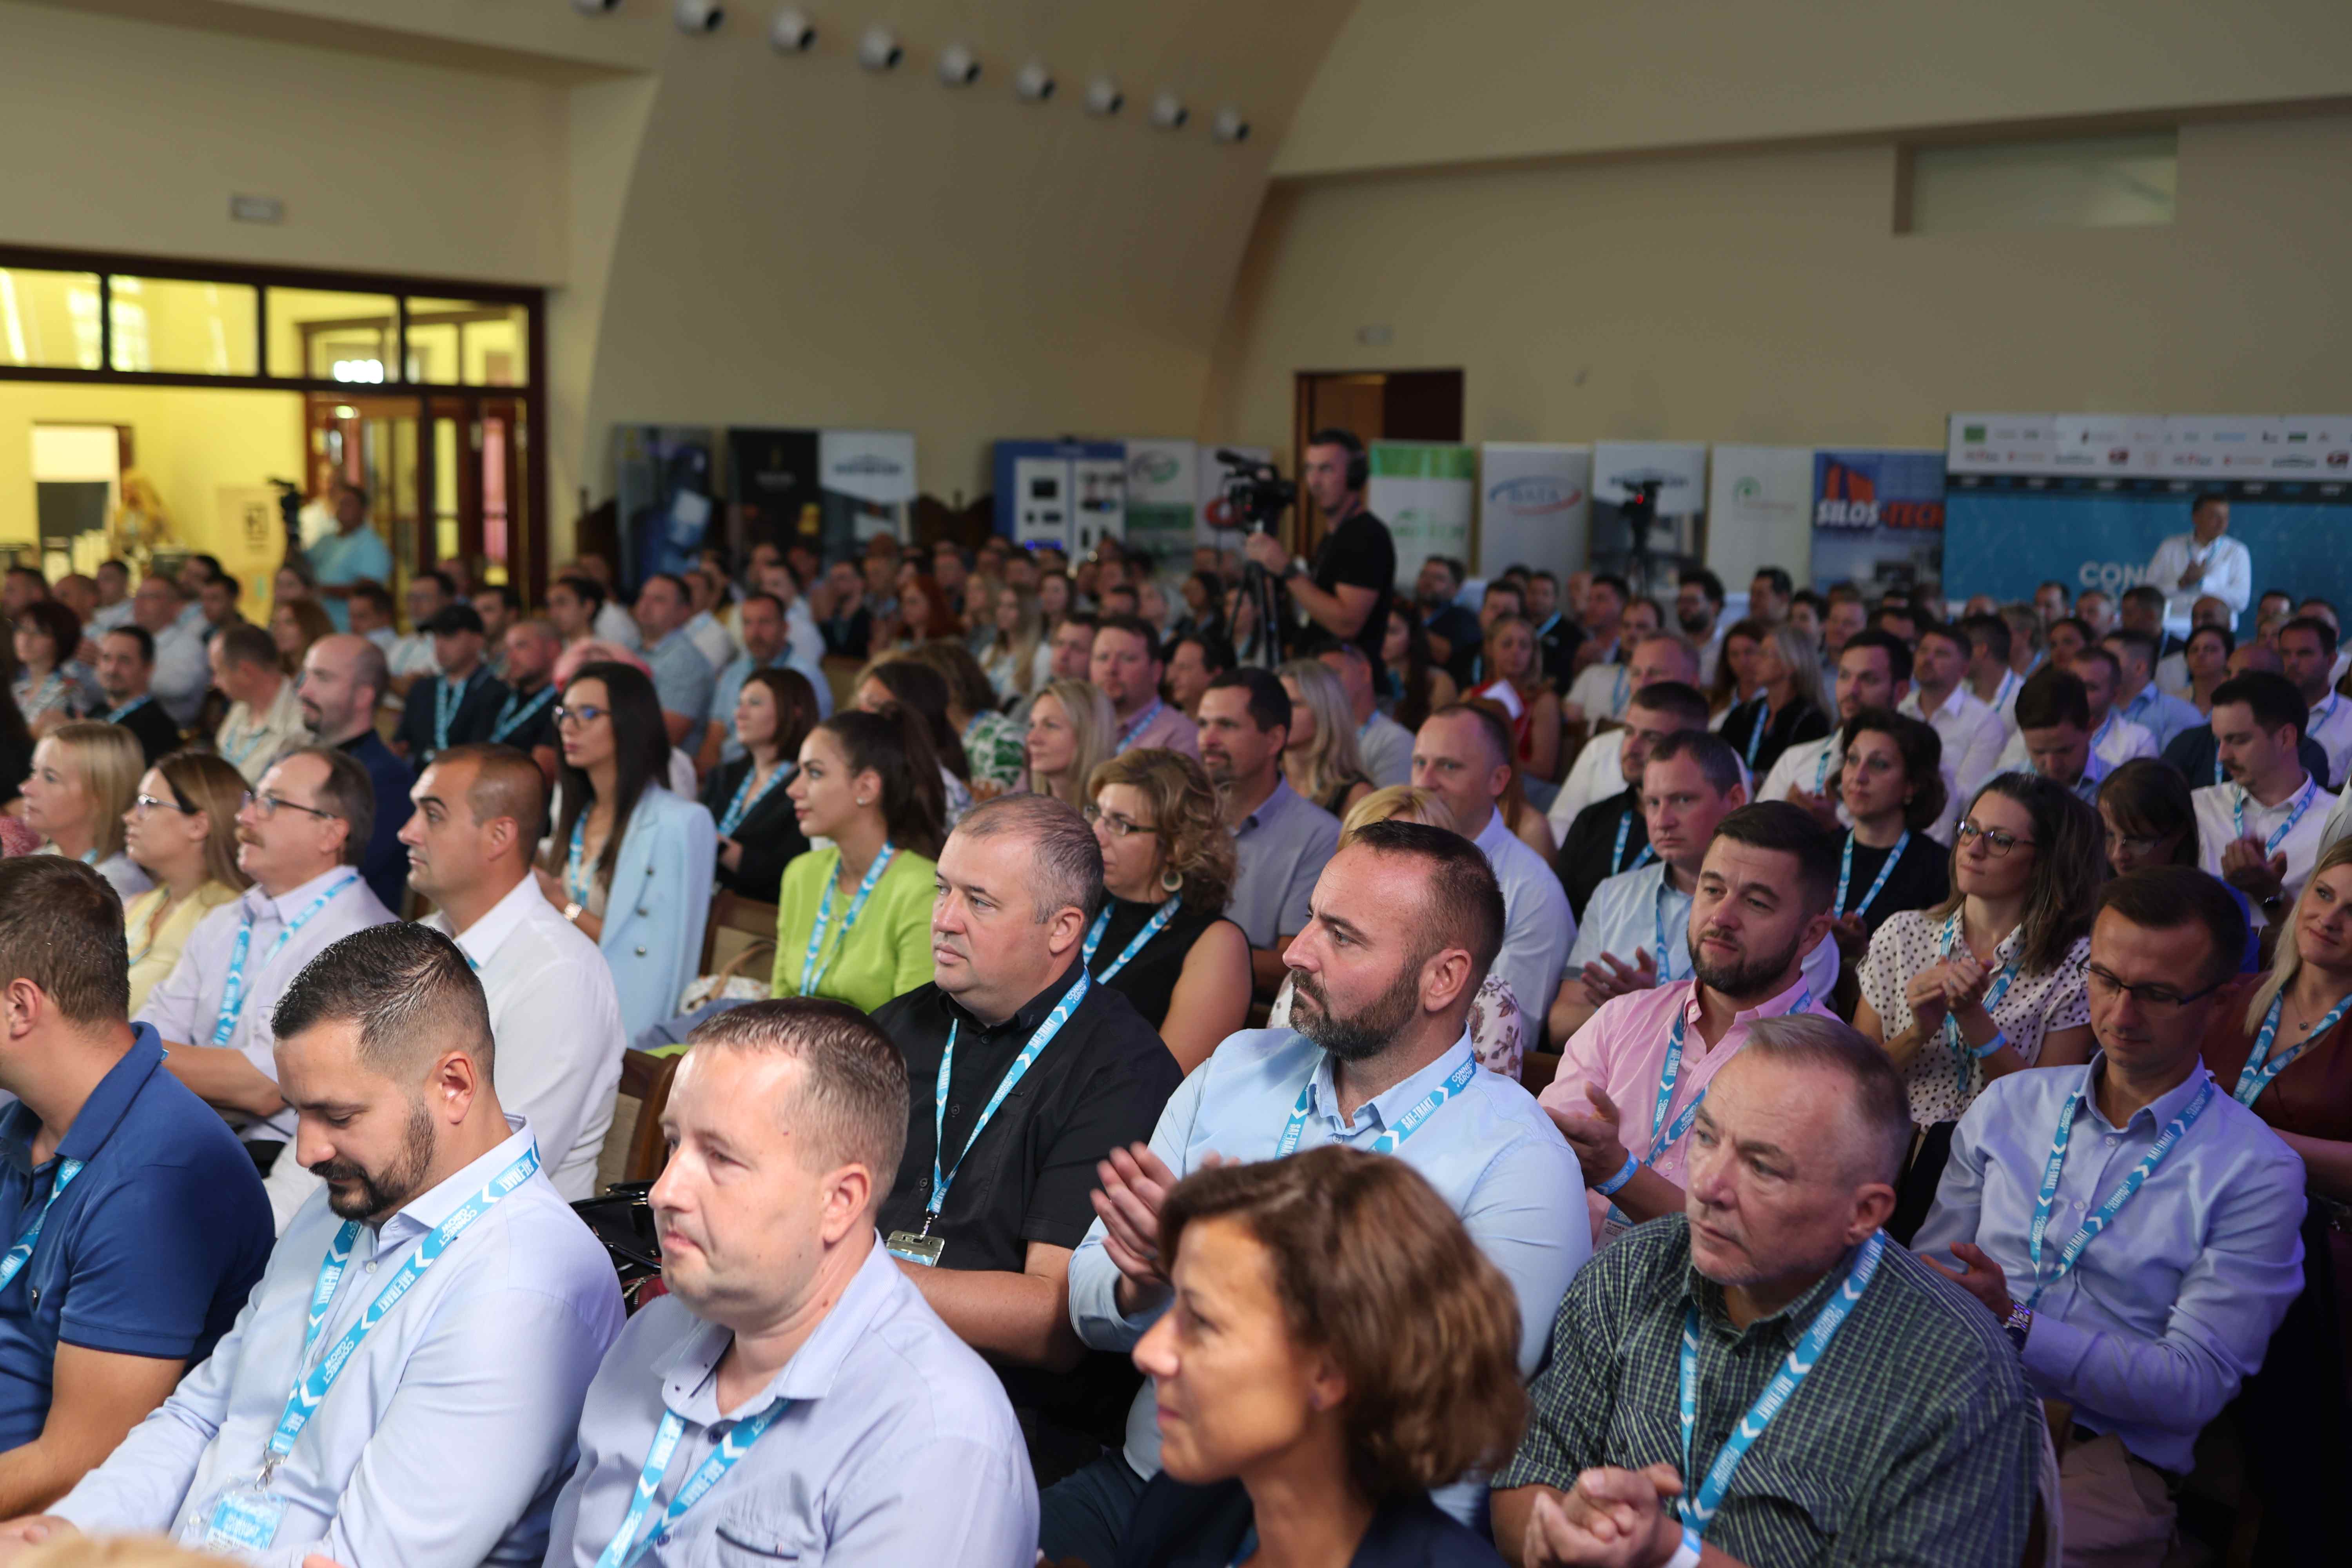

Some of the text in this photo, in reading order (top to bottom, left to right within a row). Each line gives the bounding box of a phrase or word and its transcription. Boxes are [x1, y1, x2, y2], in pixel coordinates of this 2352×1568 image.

[1066, 974, 1087, 1000] CONNECT
[1027, 1017, 1056, 1050] SAT-TRAKT
[1452, 1057, 1474, 1082] CONNECT
[991, 1070, 1014, 1103] CONNECT
[1401, 1096, 1436, 1130] SAT-TRAKT
[2147, 1130, 2176, 1160] SAT-TRAKT
[499, 1157, 534, 1192] SAT-TRAKT
[2045, 1158, 2062, 1189] SAT-TRAKT
[439, 1209, 477, 1247] CONNECT
[2062, 1228, 2089, 1261] SAT-TRAKT
[1857, 1239, 1882, 1283] SAT-TRAKT
[376, 1269, 416, 1314] SAT-TRAKT
[323, 1340, 354, 1385] CONNECT
[1757, 1375, 1795, 1421] SAT-TRAKT
